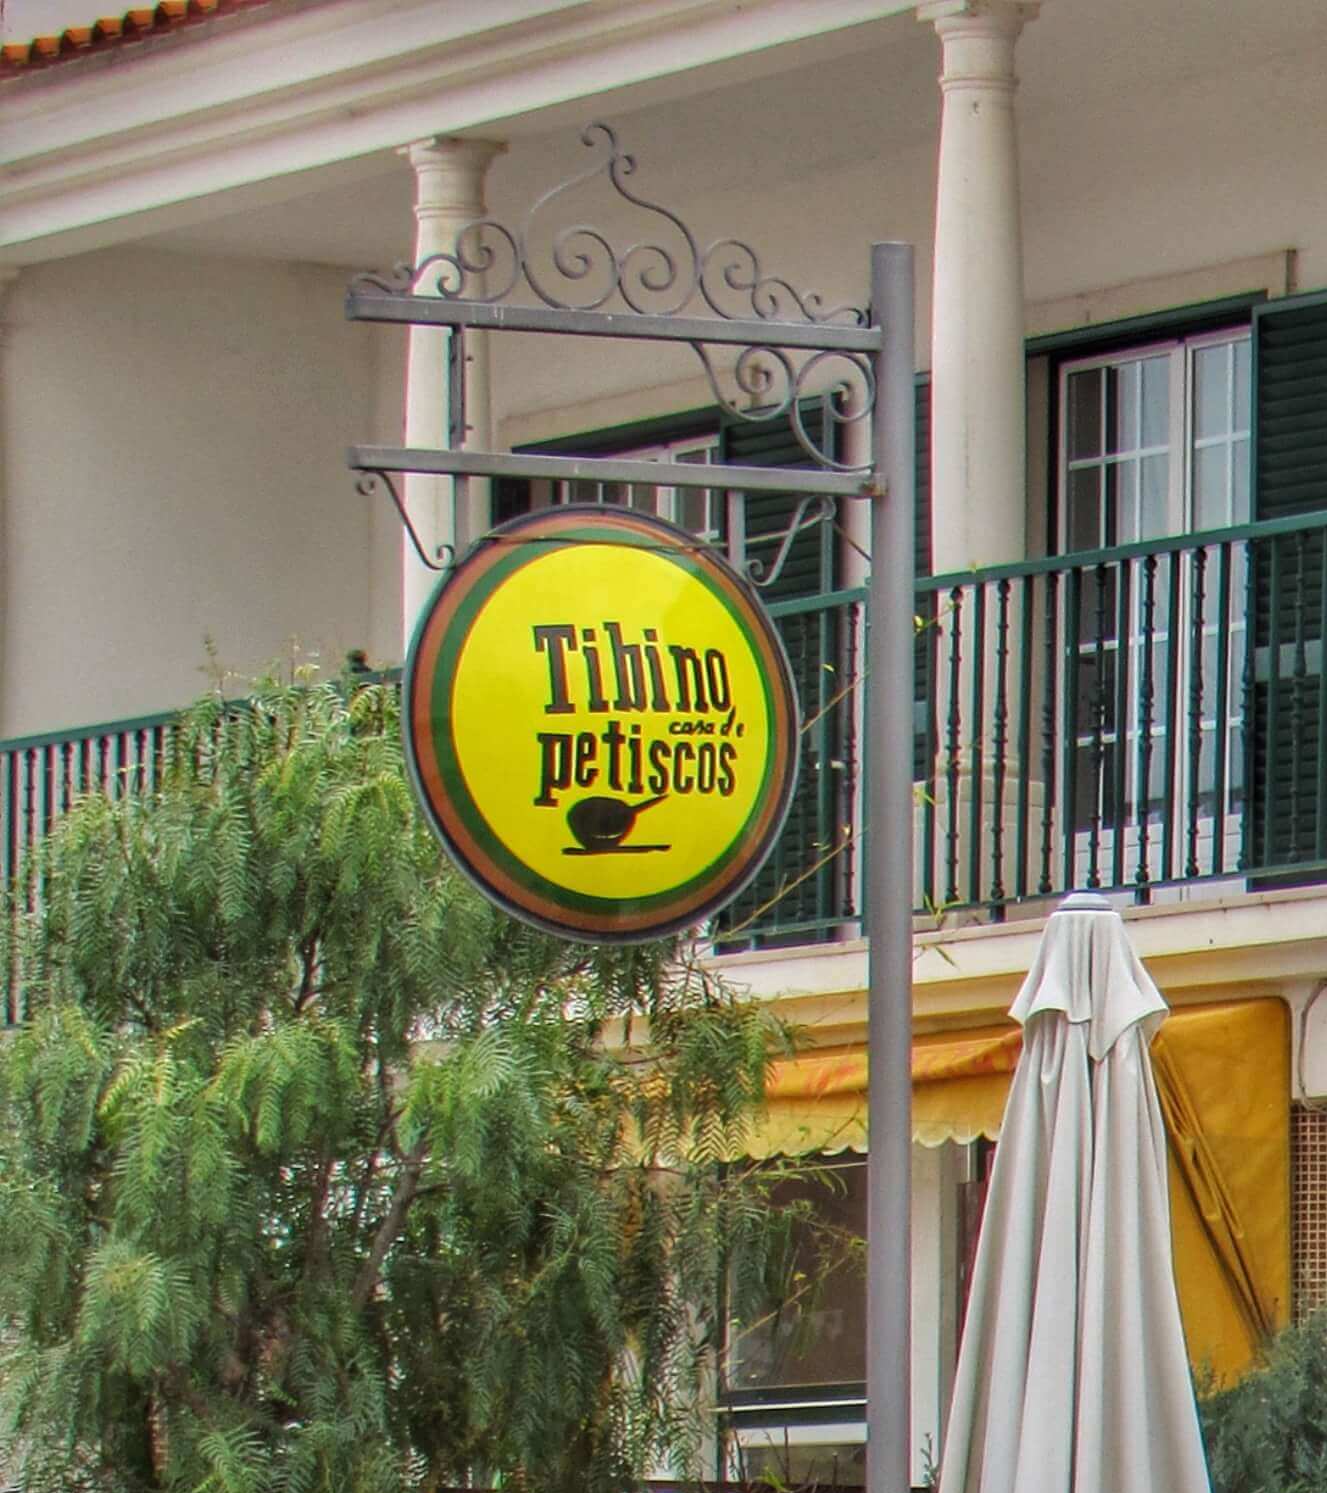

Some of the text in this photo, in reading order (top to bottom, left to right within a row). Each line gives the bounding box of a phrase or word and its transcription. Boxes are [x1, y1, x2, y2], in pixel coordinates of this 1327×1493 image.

[533, 622, 731, 714] Tibino
[534, 721, 738, 808] petiscos
[669, 706, 745, 739] casa de
